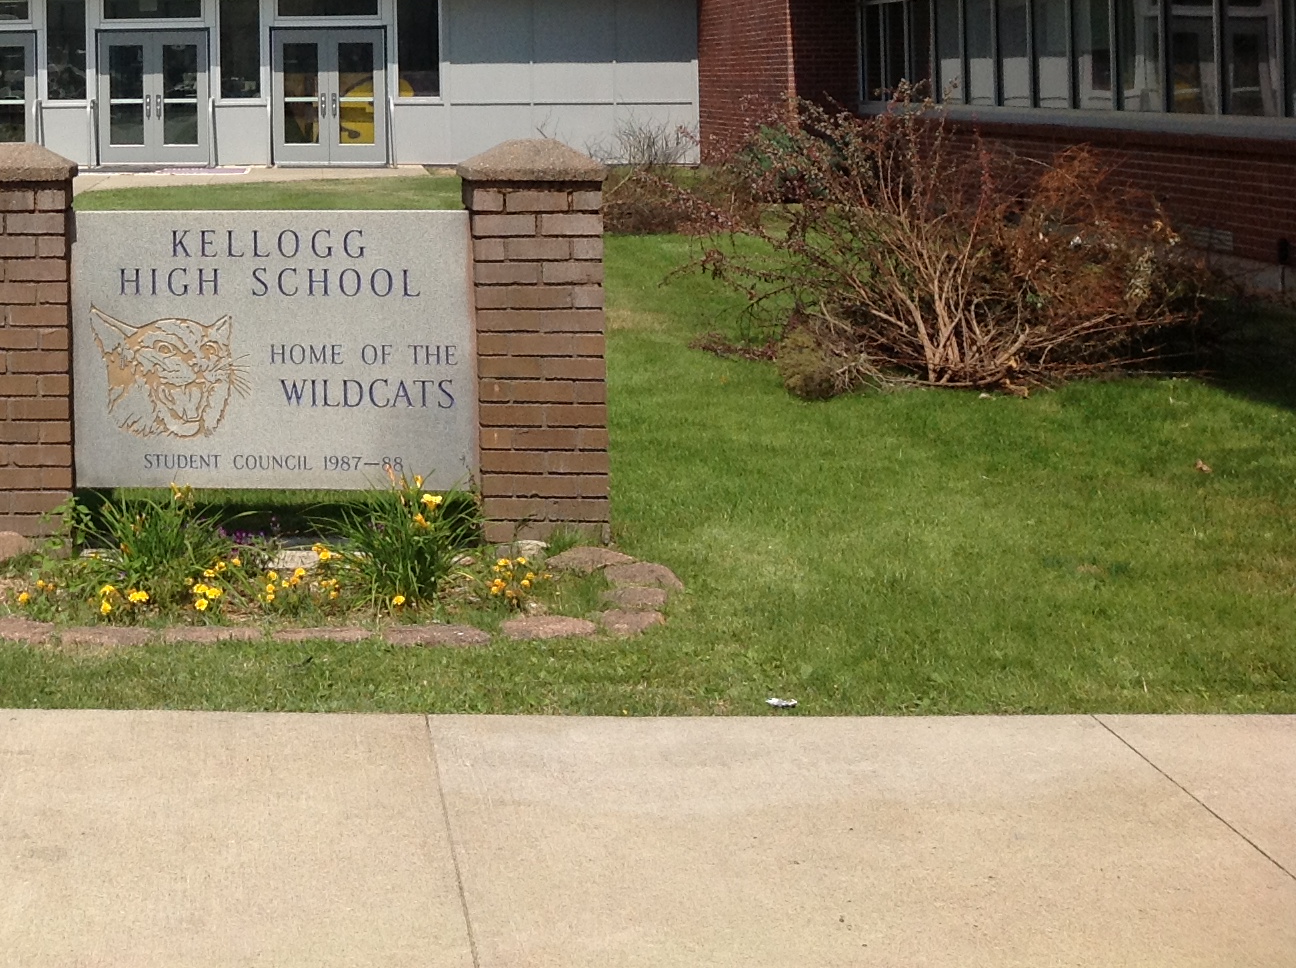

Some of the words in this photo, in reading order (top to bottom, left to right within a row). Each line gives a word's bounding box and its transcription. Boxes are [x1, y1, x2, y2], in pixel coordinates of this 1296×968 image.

[172, 229, 366, 259] KELLOGG
[119, 267, 221, 296] HIGH
[252, 268, 421, 297] SCHOOL
[270, 344, 344, 365] HOME
[362, 344, 393, 365] OF
[408, 345, 459, 366] THE
[280, 379, 456, 409] WILDCATS
[144, 454, 221, 469] STUDENT
[233, 455, 313, 471] COUNCIL
